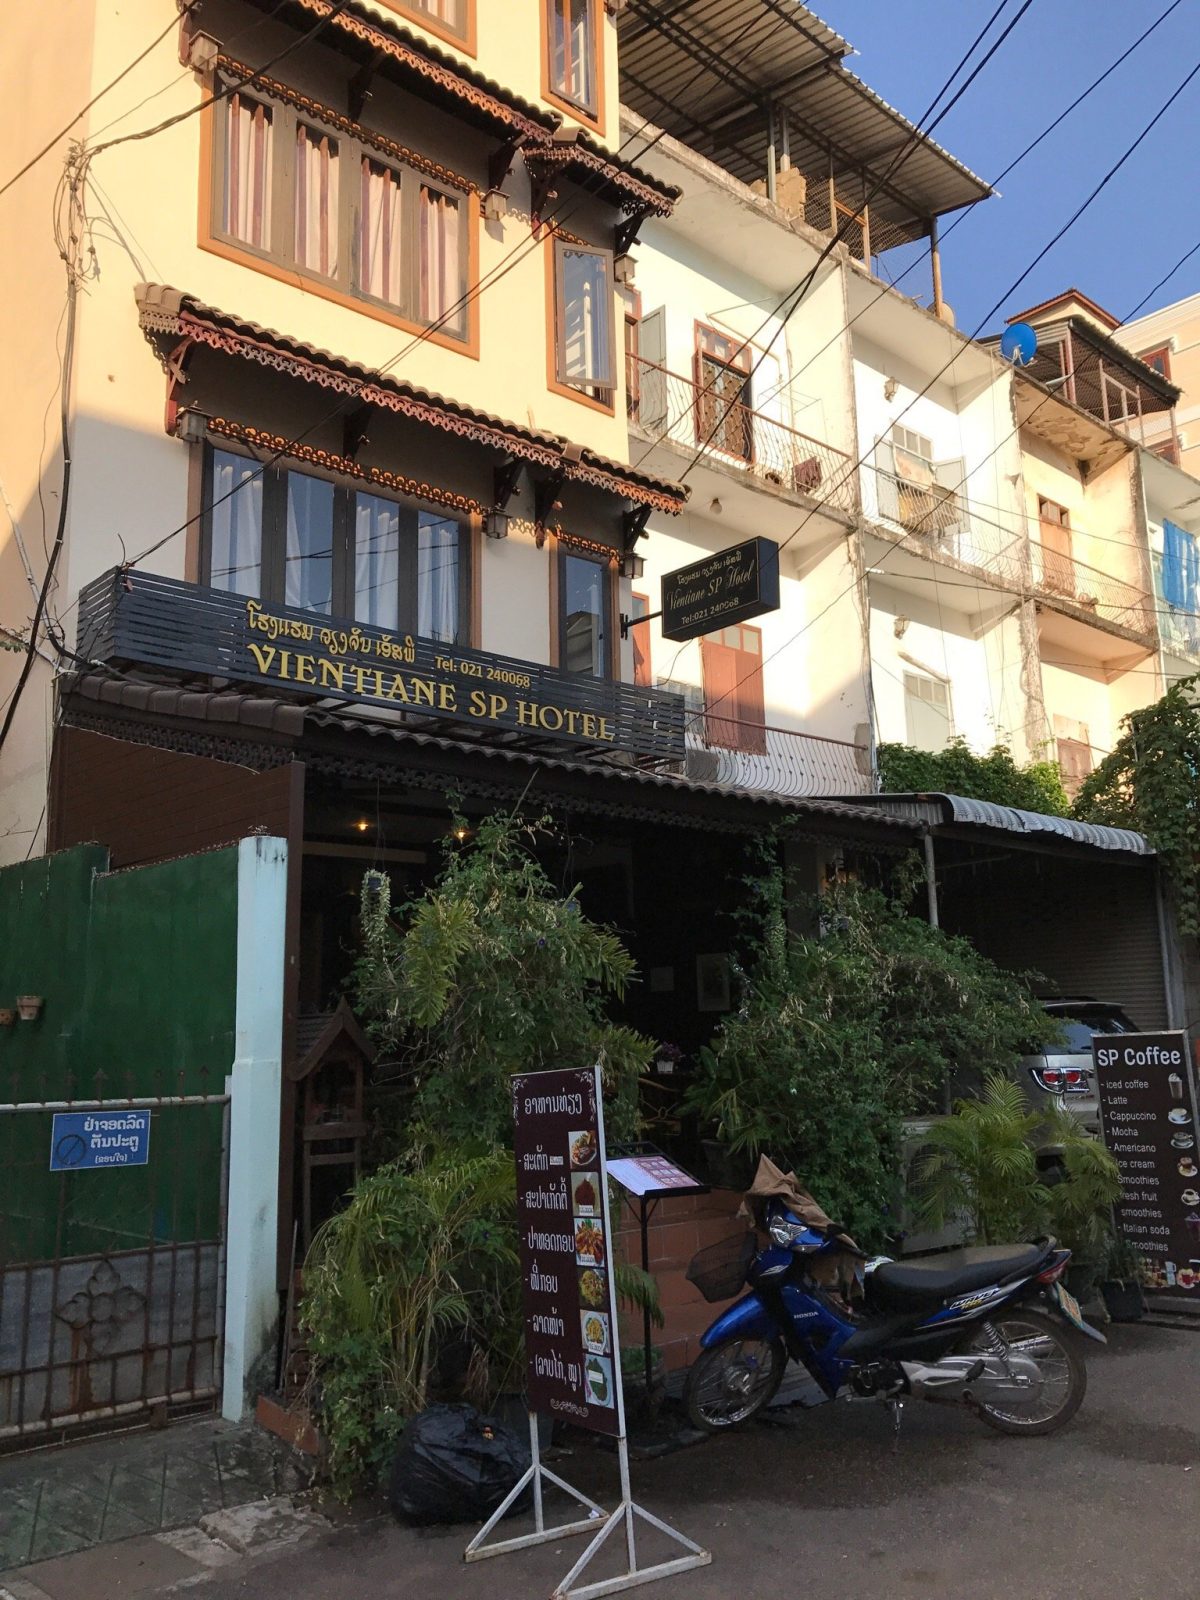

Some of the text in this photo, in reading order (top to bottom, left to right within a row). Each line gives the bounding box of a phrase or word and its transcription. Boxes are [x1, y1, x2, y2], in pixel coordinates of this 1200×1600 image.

[667, 559, 755, 611] Vientiane SP Hotel
[319, 626, 371, 655] ວຽງຈັນ
[435, 656, 531, 689] Tel: 021 240068
[247, 643, 615, 742] VIENTIANE SP HOTEL
[1097, 1046, 1181, 1067] SP Coffee
[1124, 1080, 1149, 1089] coffee
[524, 1087, 583, 1116] ອາຫານທ່ຽງ
[1108, 1096, 1128, 1105] Latte
[1109, 1111, 1157, 1122] Cappuccino
[1111, 1127, 1139, 1136] Mocha
[1113, 1143, 1157, 1153] Americano
[1129, 1160, 1156, 1169] cream
[1117, 1175, 1160, 1185] Smoothies
[1141, 1191, 1158, 1202] fruit
[1121, 1208, 1163, 1218] smoothies
[1123, 1223, 1171, 1235] Italian soda
[793, 1311, 819, 1319] HONDA
